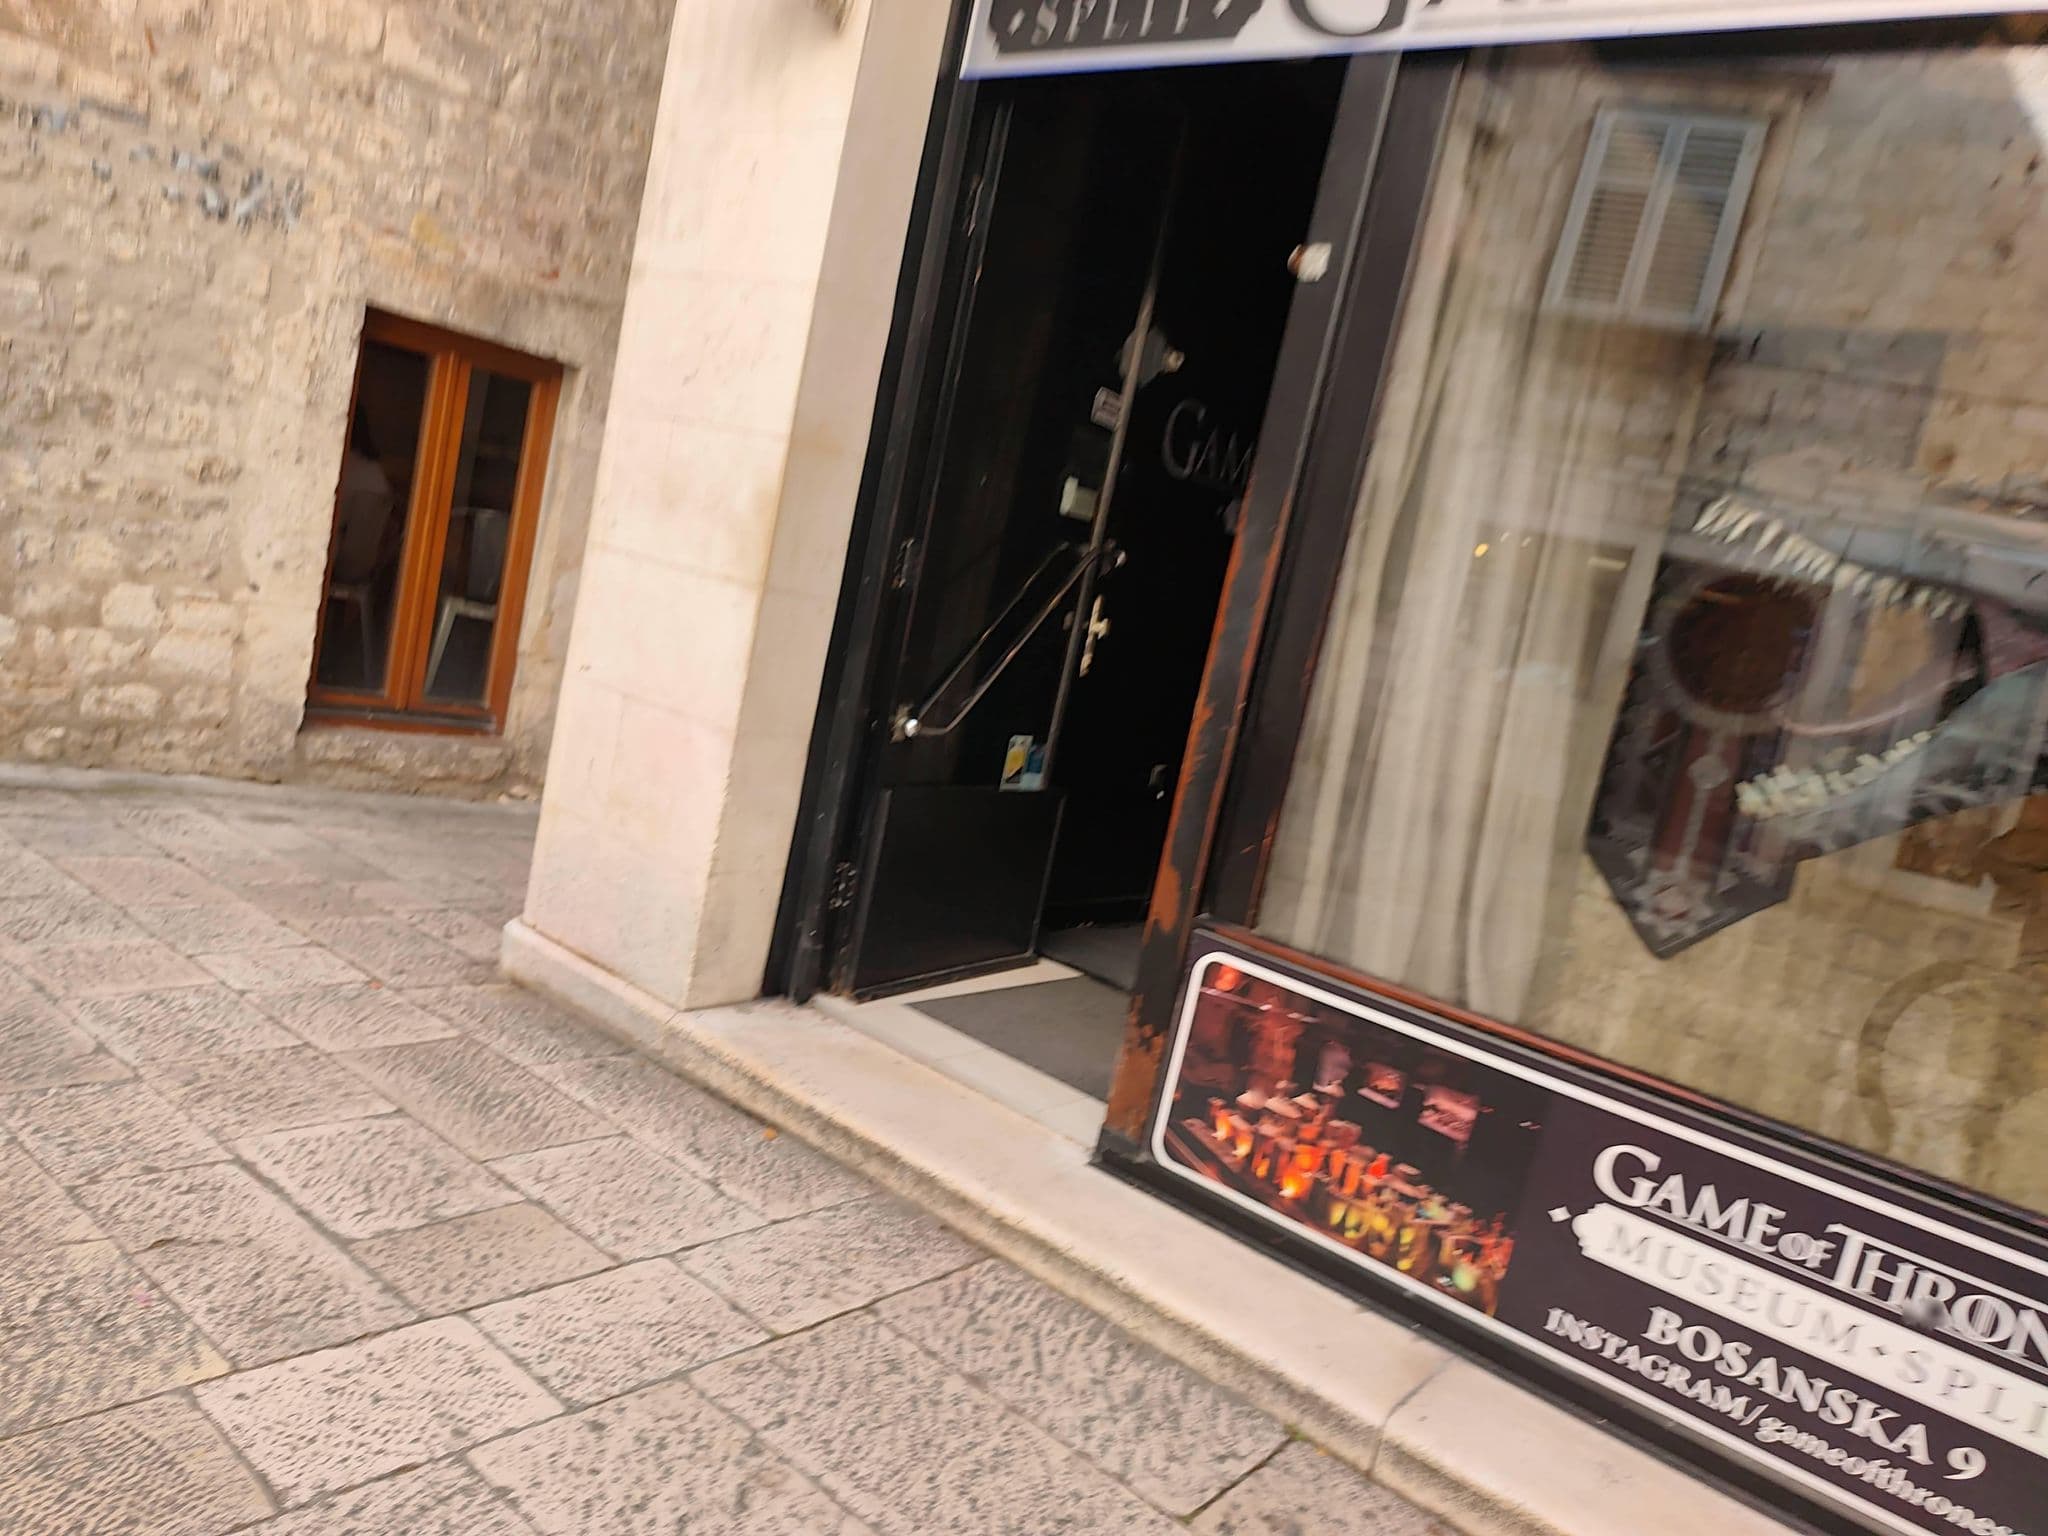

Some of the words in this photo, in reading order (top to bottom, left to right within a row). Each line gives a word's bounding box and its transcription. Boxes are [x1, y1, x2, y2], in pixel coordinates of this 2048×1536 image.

[1161, 397, 1253, 482] GAM
[1592, 1144, 1786, 1253] GAME
[1778, 1232, 1837, 1268] OF
[1605, 1223, 1863, 1354] MUSEUM
[1641, 1306, 1934, 1465] BOSANSKA
[1942, 1446, 1987, 1480] 9
